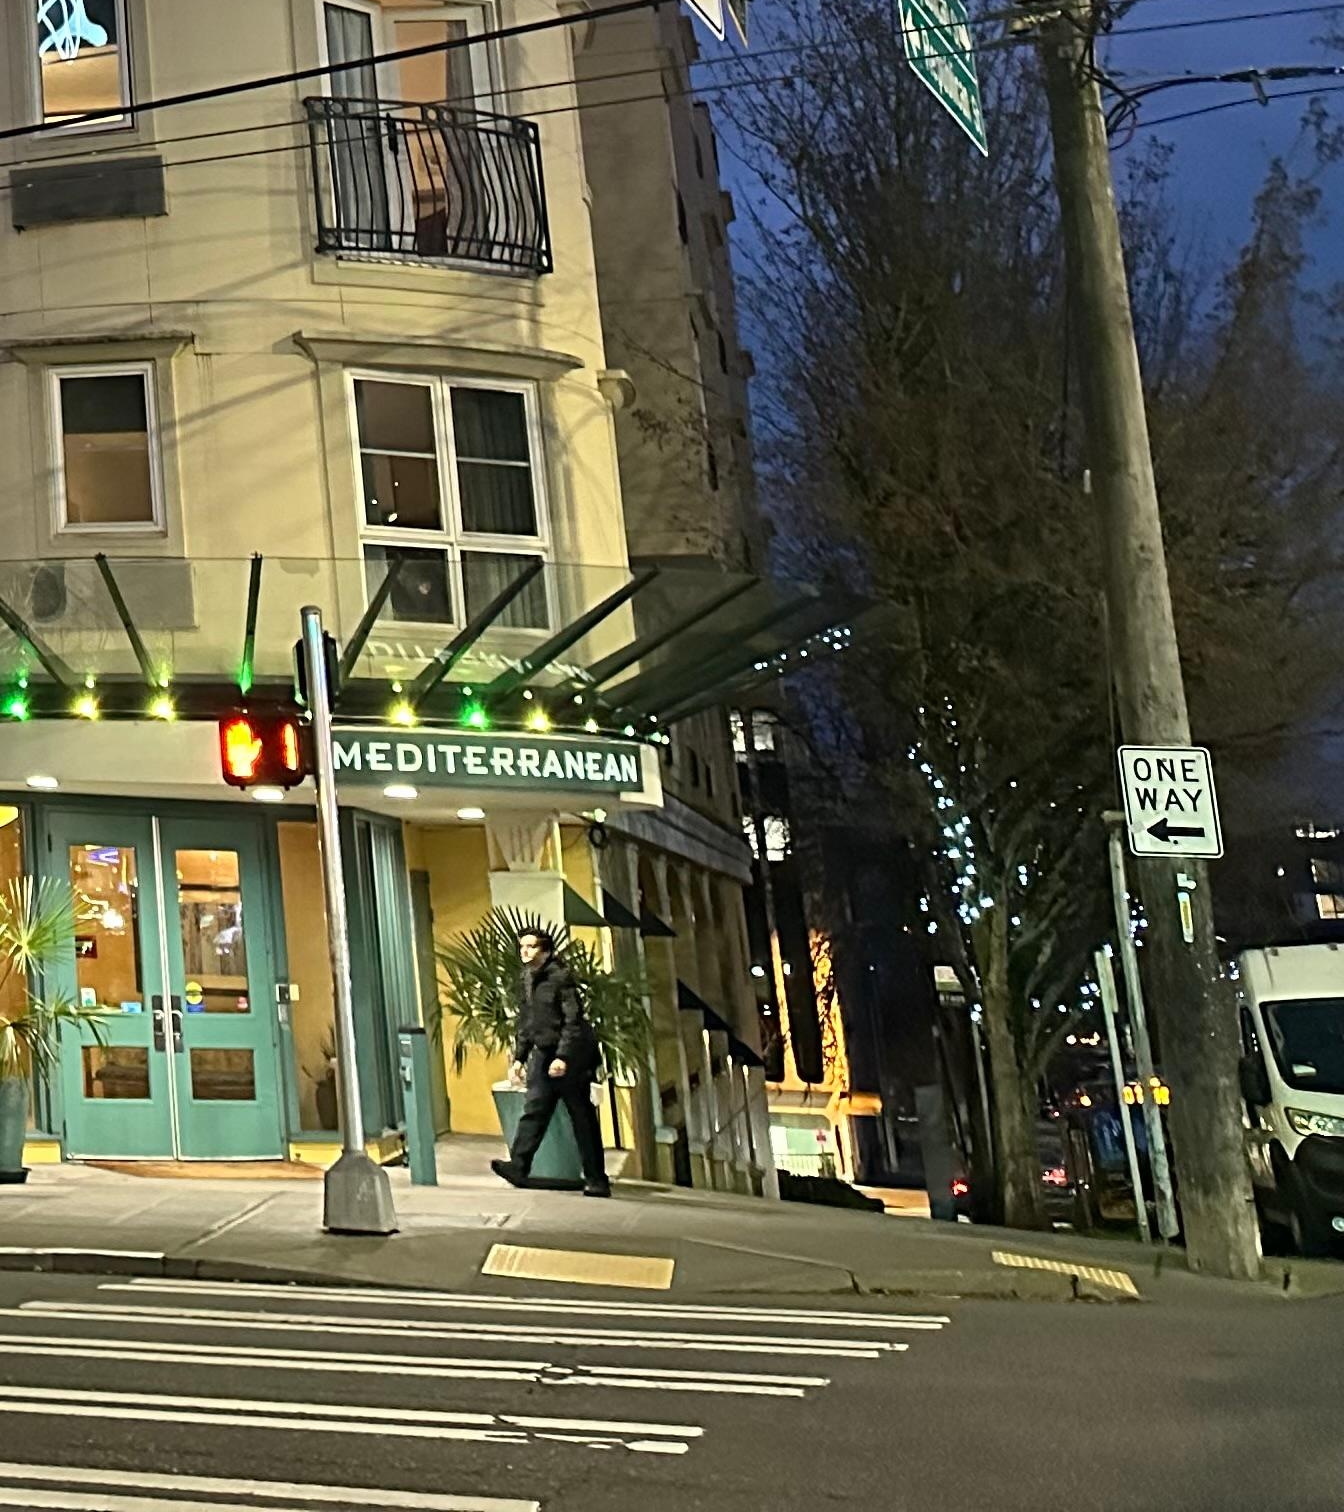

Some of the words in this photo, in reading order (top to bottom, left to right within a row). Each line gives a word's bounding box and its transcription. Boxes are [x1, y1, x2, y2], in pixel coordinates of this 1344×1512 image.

[333, 740, 638, 783] MEDITERRANEAN
[1133, 757, 1200, 783] ONE
[1135, 787, 1203, 813] WAY
